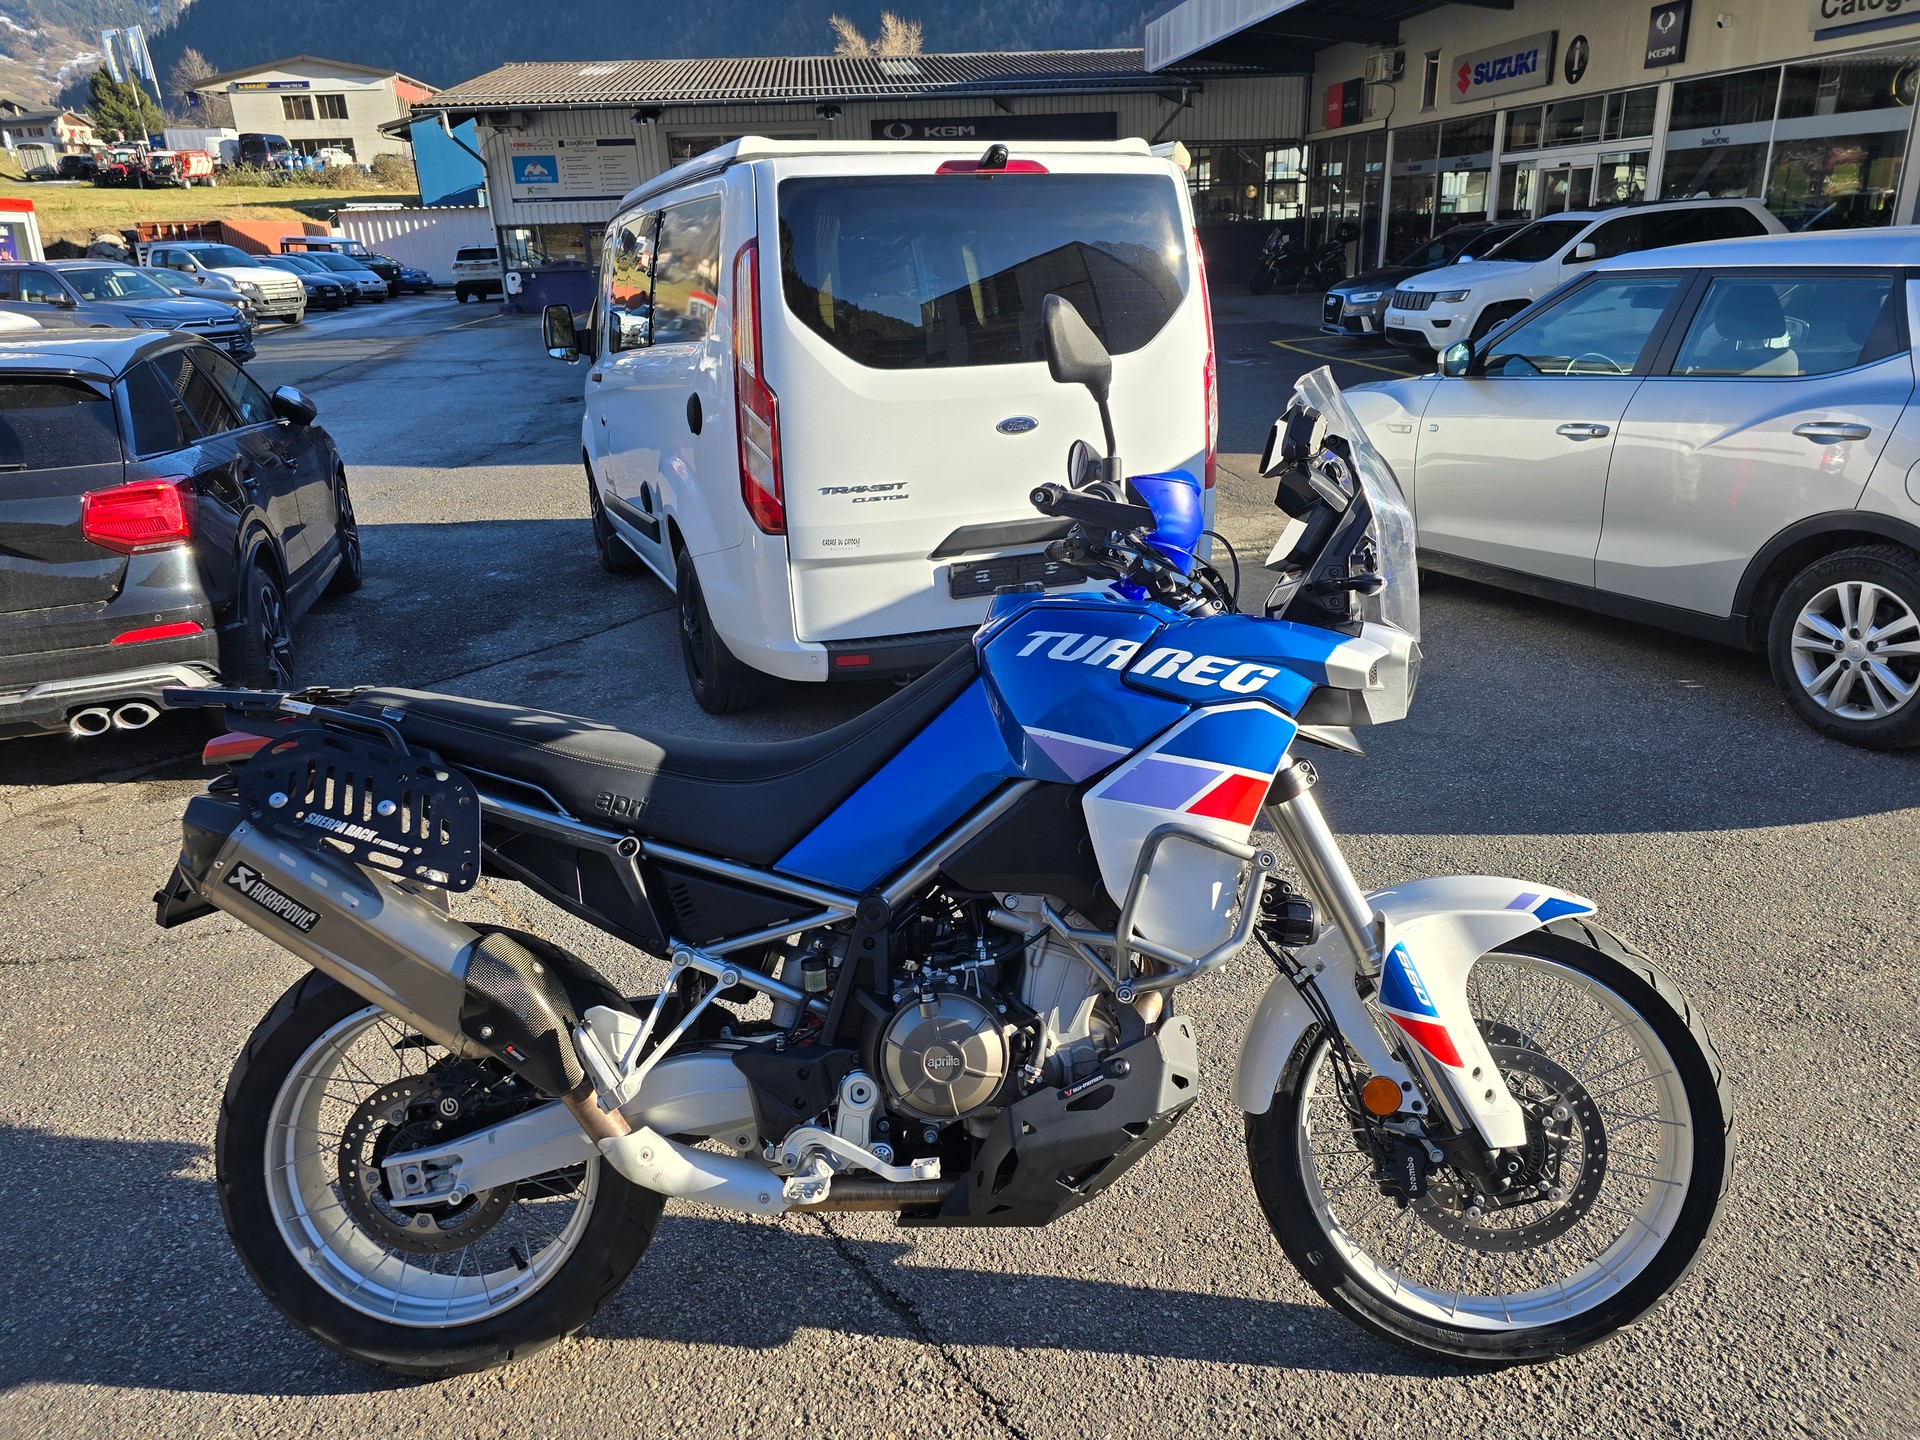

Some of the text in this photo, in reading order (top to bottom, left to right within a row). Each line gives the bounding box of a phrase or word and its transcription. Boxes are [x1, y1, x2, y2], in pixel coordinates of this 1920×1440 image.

[1821, 0, 1911, 19] Catog
[1648, 45, 1676, 60] KGM
[1473, 48, 1538, 85] SUZUKI
[924, 125, 976, 138] KGM
[1007, 420, 1030, 431] Ford
[817, 482, 908, 496] TRANSIT
[852, 494, 909, 504] CUSTOM
[1016, 630, 1281, 694] TUAREG
[304, 812, 348, 834] SHERPA
[343, 824, 379, 843] RACK
[1394, 949, 1433, 1008] 660
[927, 1055, 960, 1070] aprilia
[1072, 1075, 1104, 1093] SW-MOTECH
[1406, 1156, 1418, 1191] brembo
